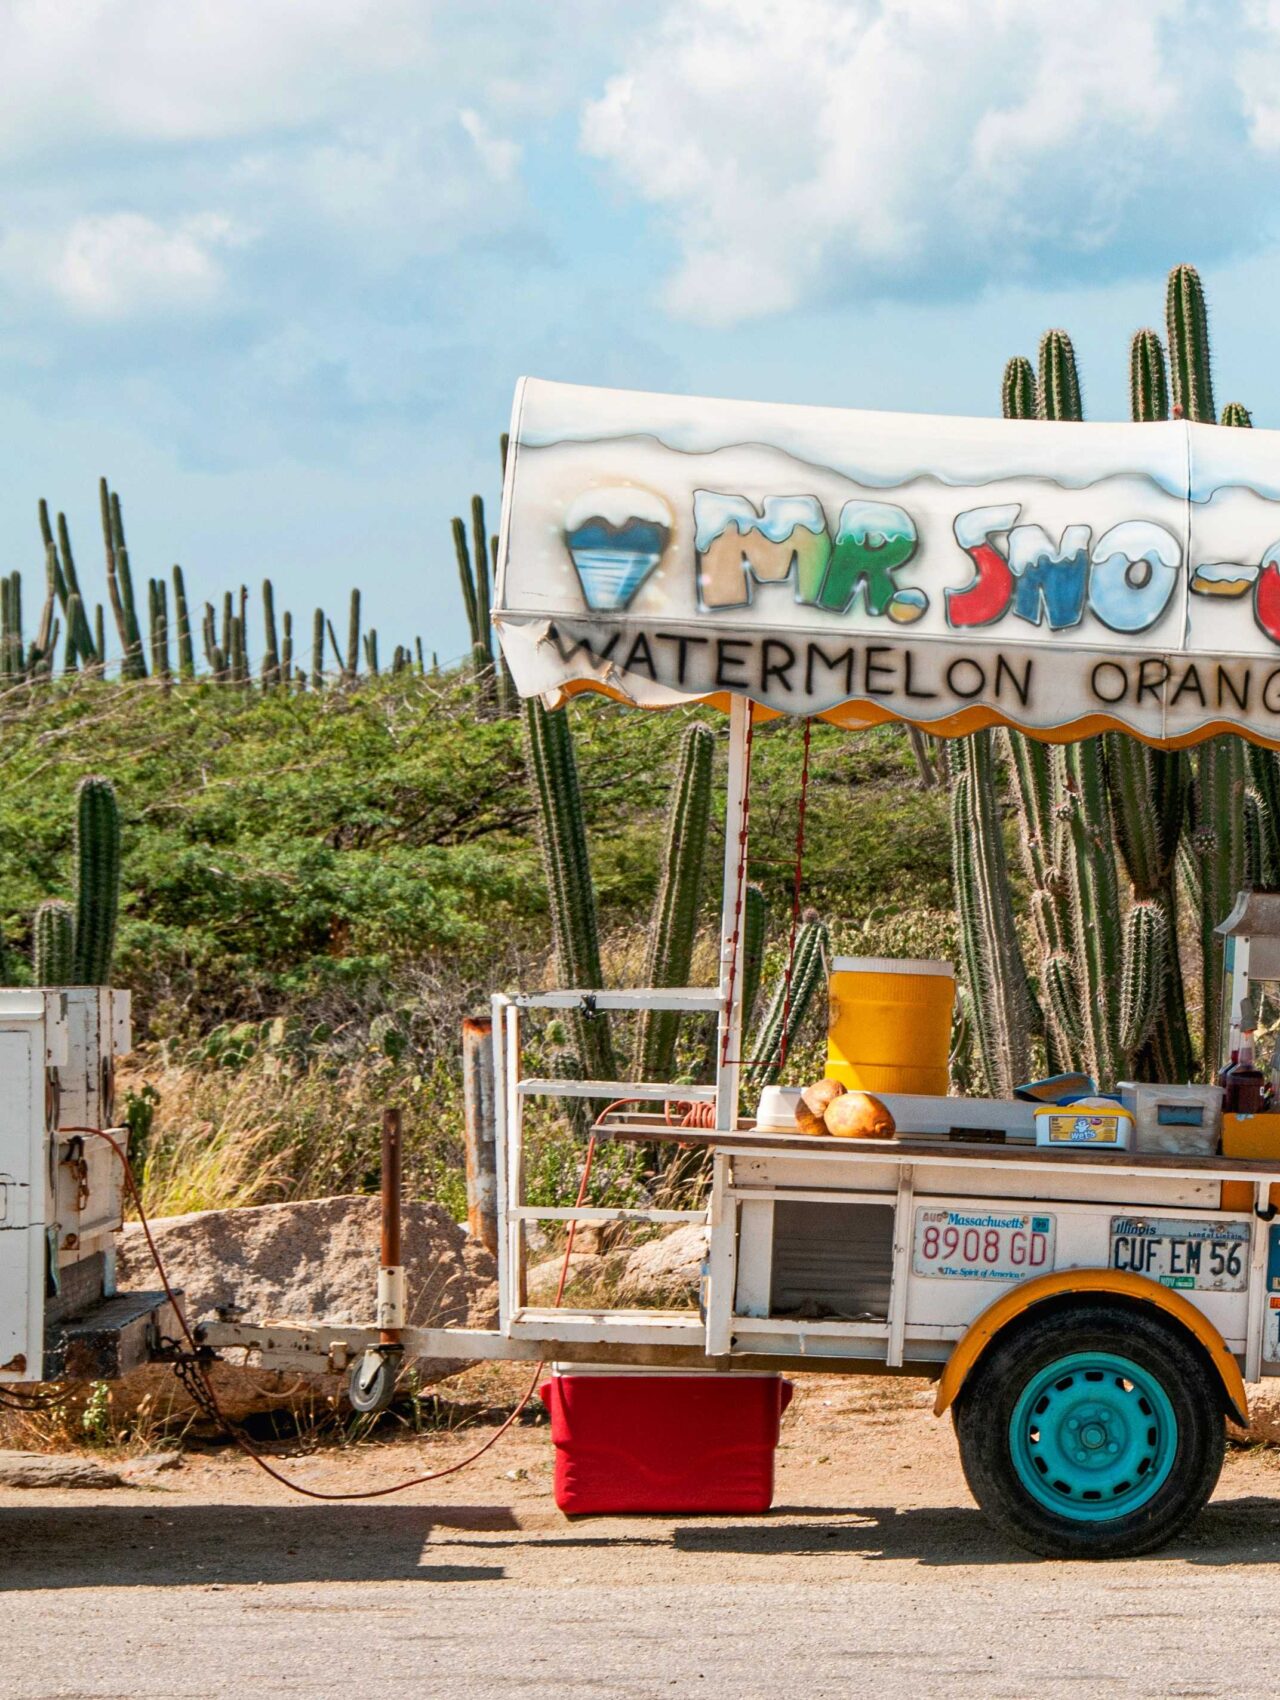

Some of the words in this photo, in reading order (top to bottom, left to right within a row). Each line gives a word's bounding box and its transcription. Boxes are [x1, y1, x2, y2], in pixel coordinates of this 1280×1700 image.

[693, 489, 929, 625] MR.
[549, 622, 1032, 704] WATERMELON
[947, 1211, 1024, 1229] Massachusetts
[1116, 1221, 1157, 1235] Illinois
[922, 1225, 1000, 1263] 8908
[1009, 1231, 1047, 1267] GD
[1114, 1236, 1162, 1272] CUF
[1169, 1238, 1203, 1275] EM
[1210, 1241, 1242, 1277] 56
[944, 1267, 959, 1276] The
[960, 1268, 979, 1278] Spirit
[980, 1269, 989, 1278] of
[991, 1269, 1021, 1279] America
